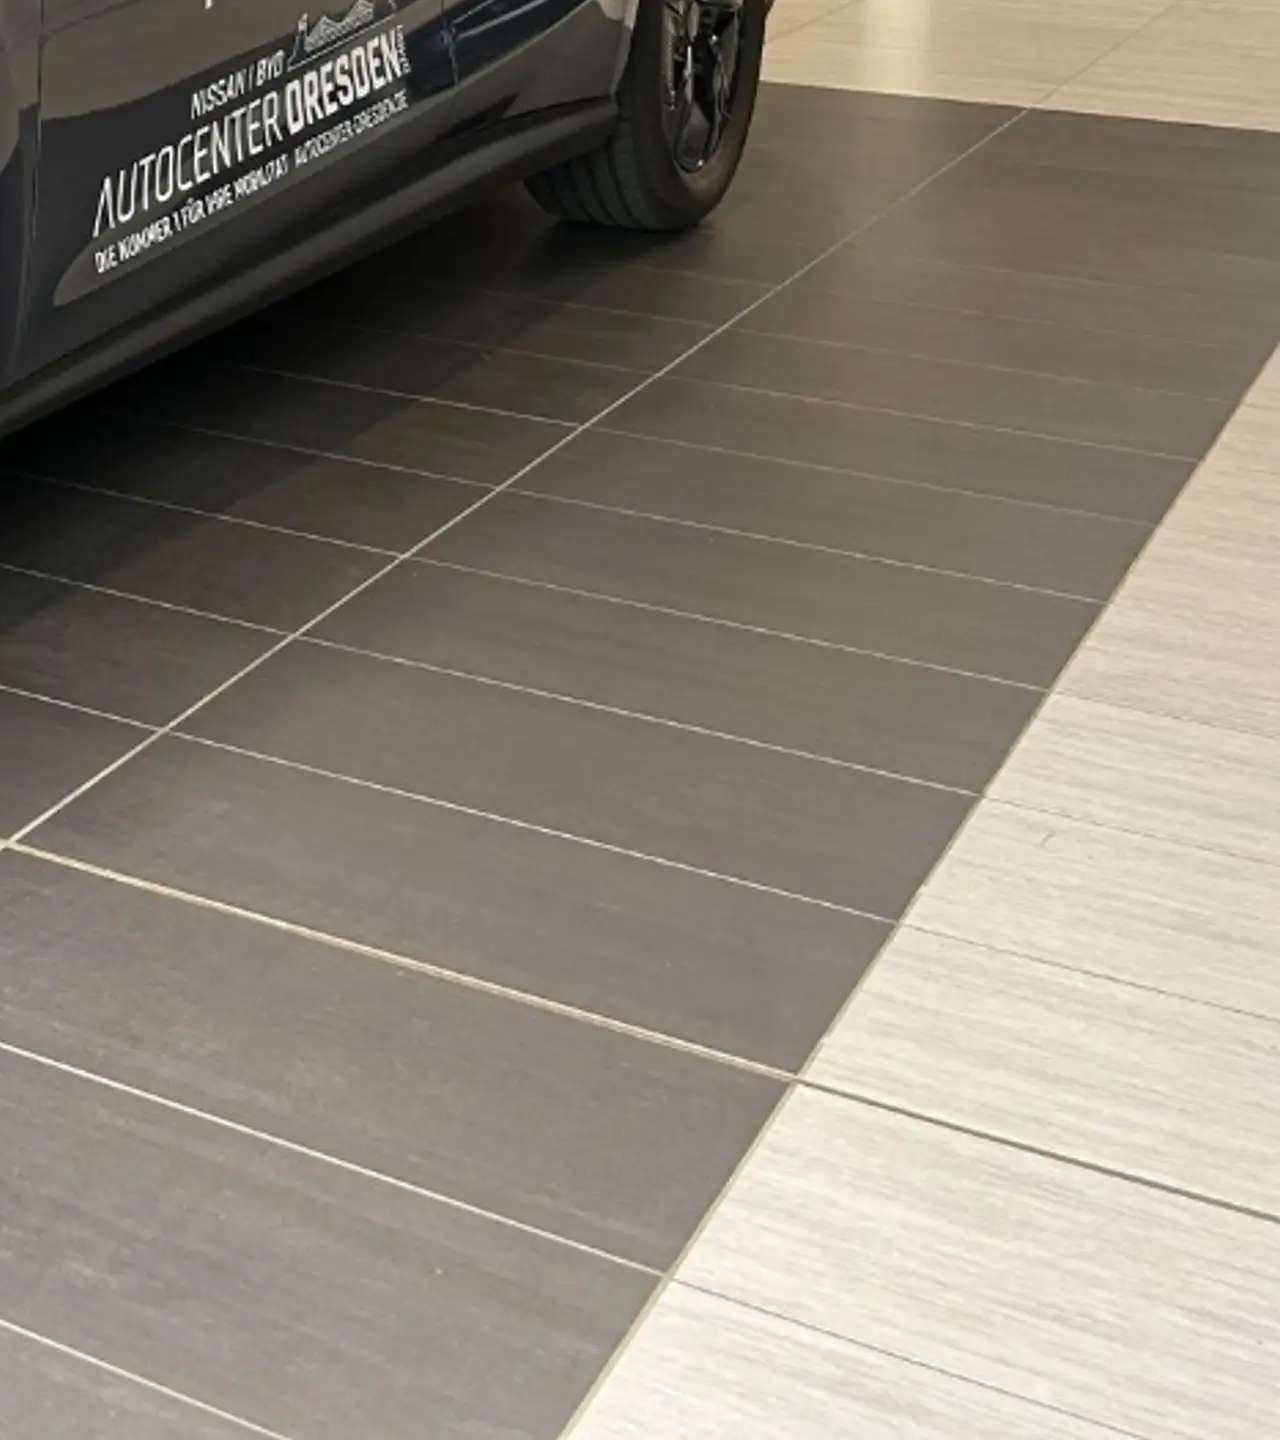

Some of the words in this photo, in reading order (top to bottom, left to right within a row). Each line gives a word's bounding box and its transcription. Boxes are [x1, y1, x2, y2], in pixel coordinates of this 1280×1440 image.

[93, 91, 284, 238] AUTOCENTER
[285, 29, 402, 136] DRESDEN
[191, 68, 247, 120] NISSAN
[256, 49, 285, 87] BYD
